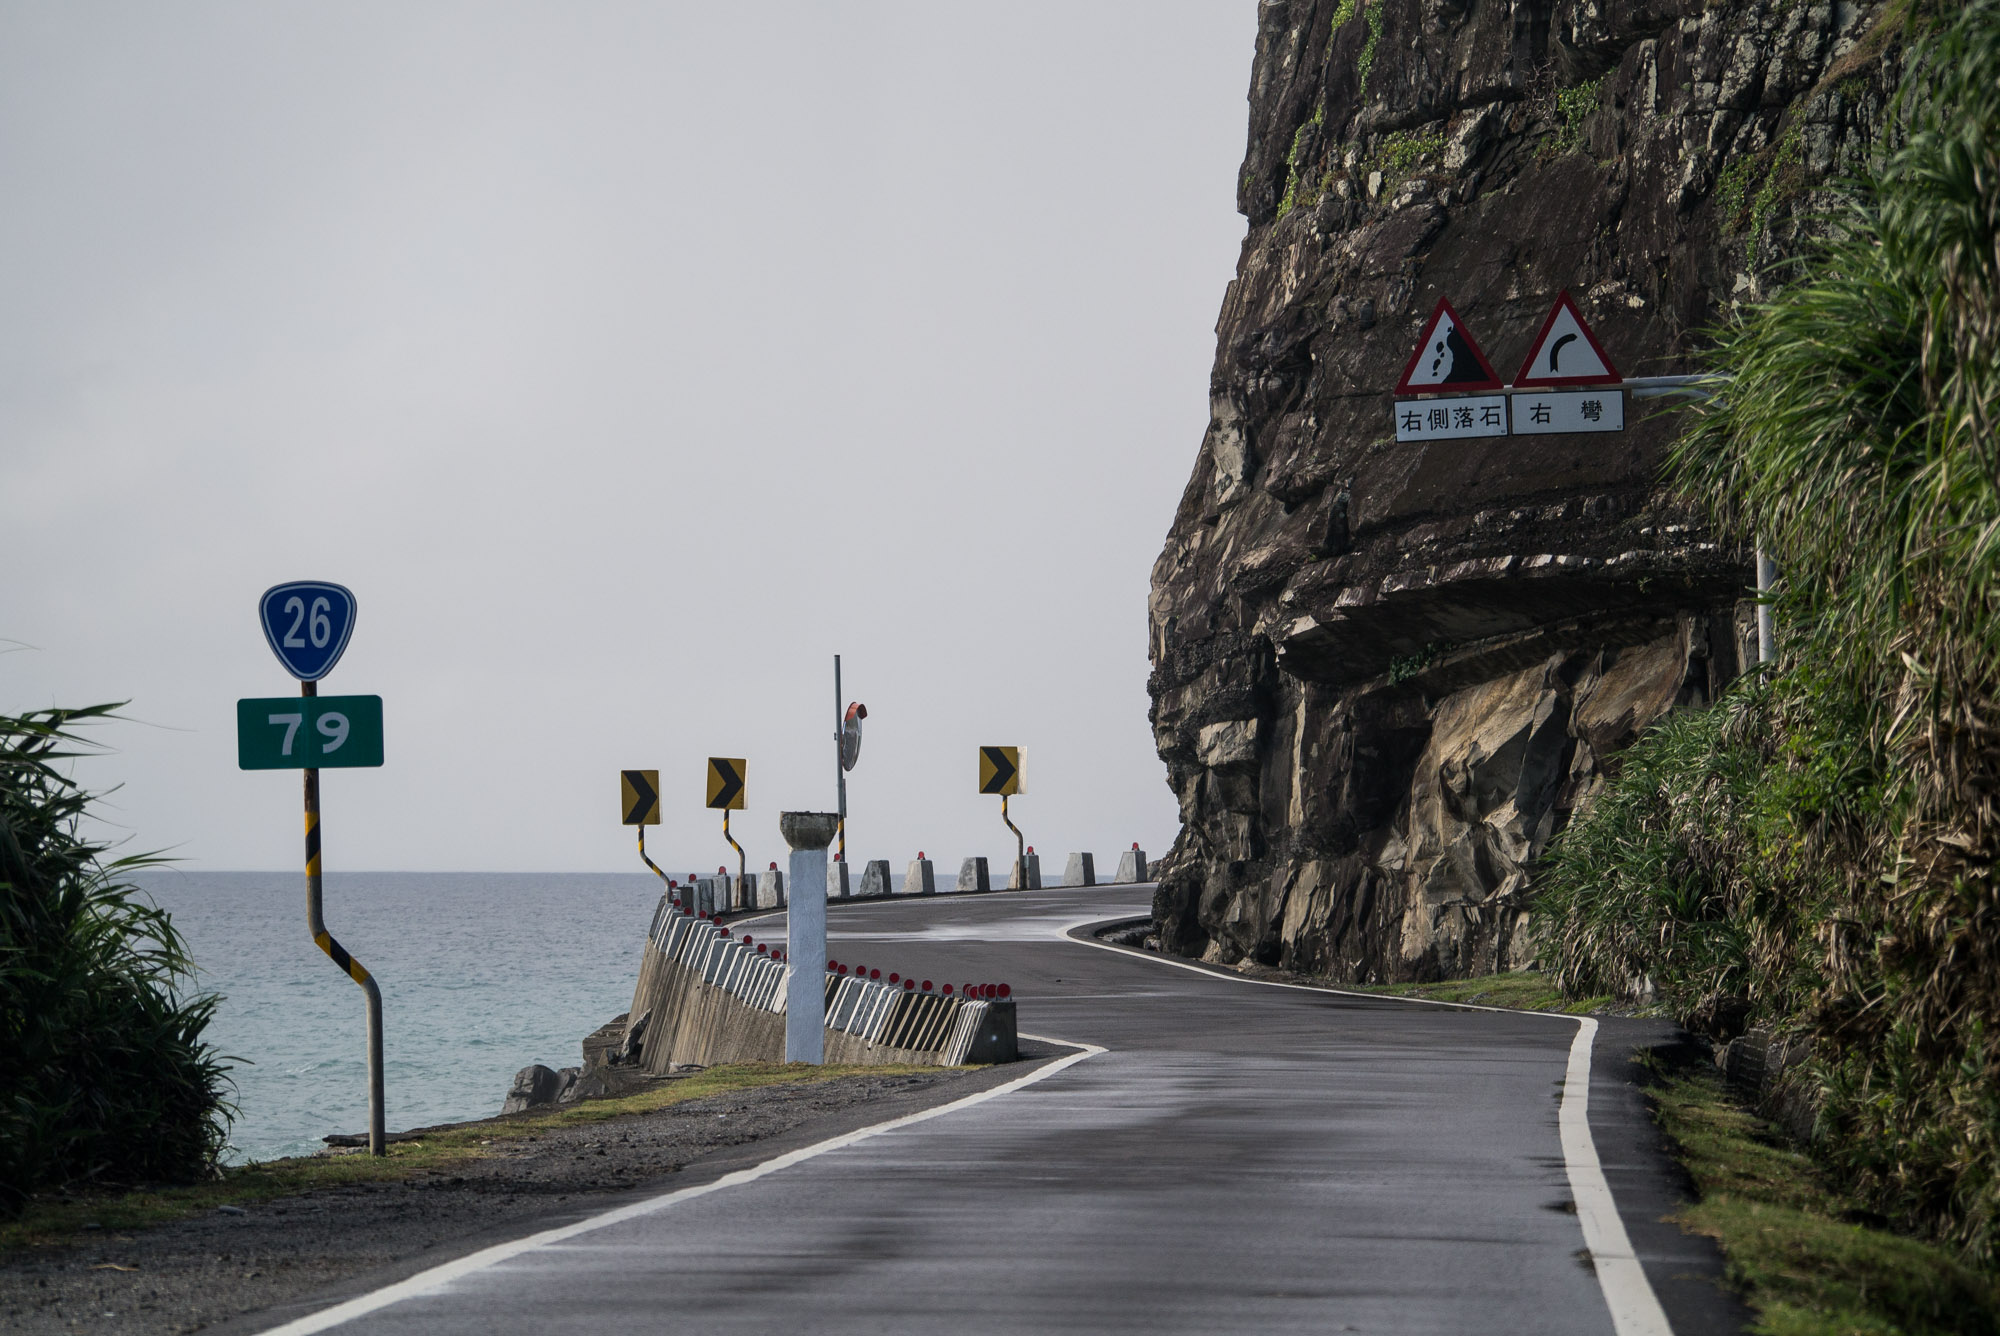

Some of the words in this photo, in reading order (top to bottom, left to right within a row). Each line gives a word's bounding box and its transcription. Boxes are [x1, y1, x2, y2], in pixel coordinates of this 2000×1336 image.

[1400, 405, 1501, 432] 右側落石
[283, 596, 331, 648] 26
[268, 711, 350, 756] 79
